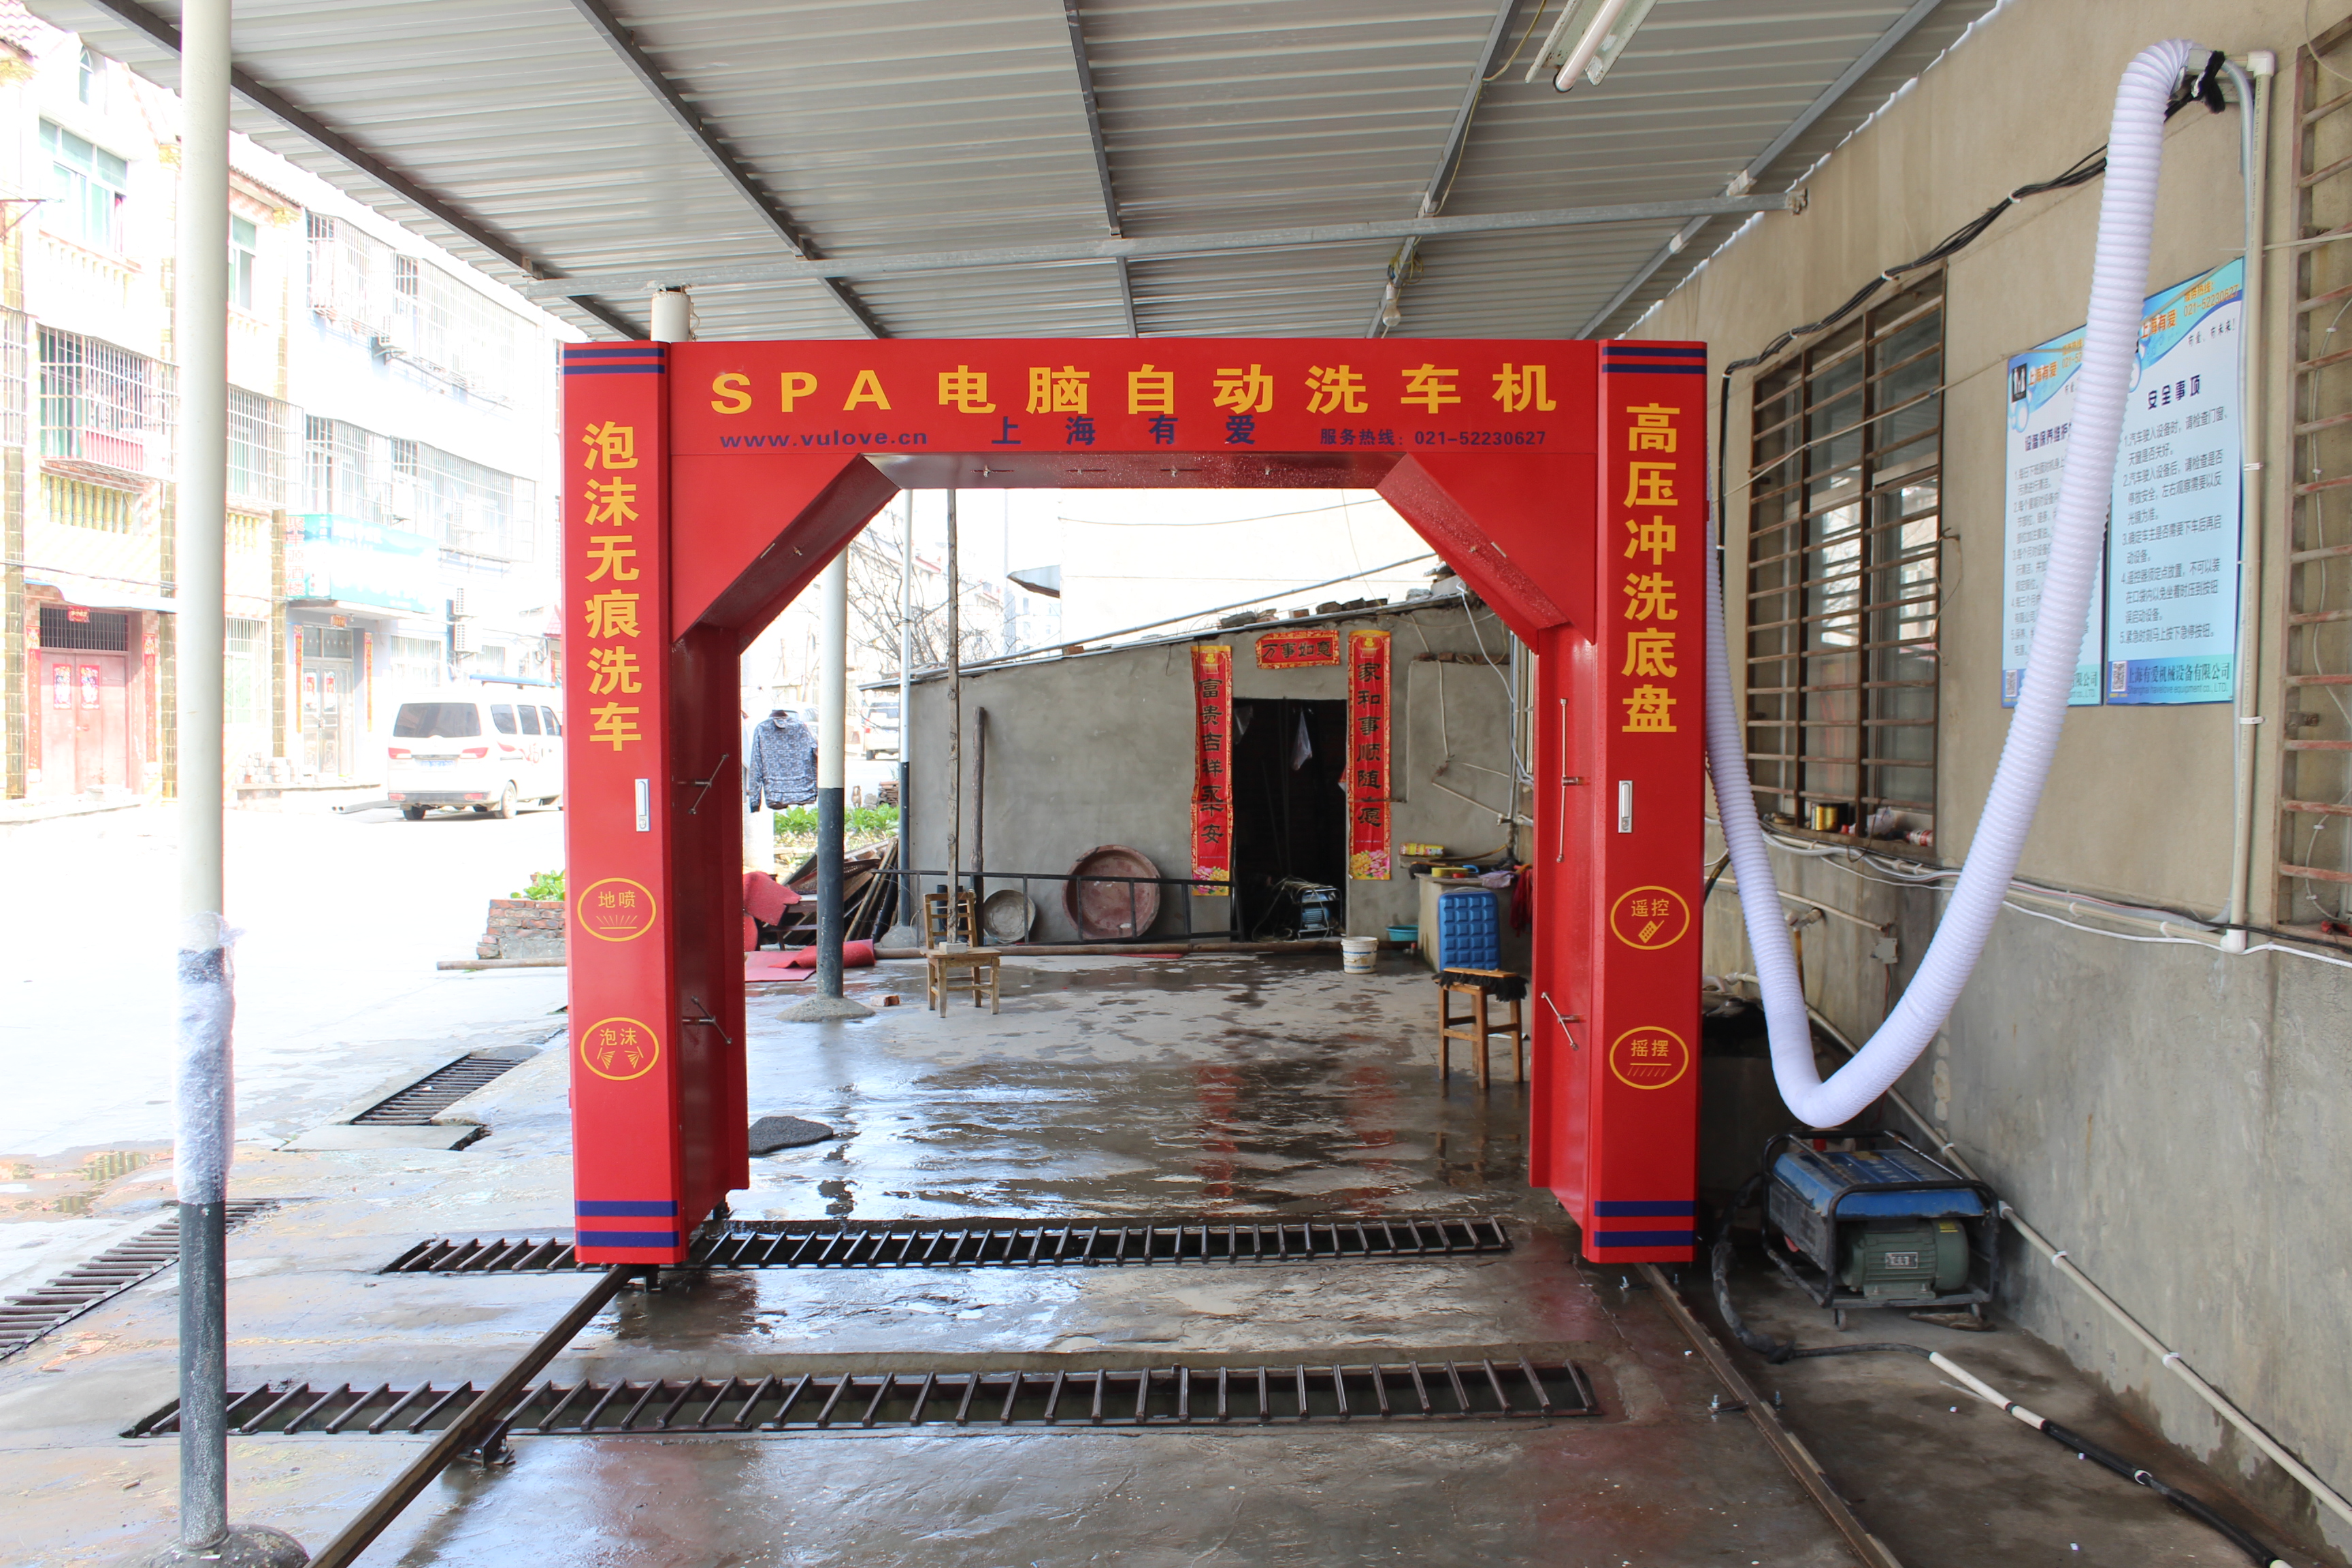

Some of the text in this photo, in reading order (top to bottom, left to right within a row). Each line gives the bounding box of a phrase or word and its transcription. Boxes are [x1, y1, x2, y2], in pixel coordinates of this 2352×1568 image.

[2183, 284, 2240, 317] 021-52230627
[2140, 309, 2177, 339] 上海有爱
[2027, 361, 2057, 386] 上海有爱
[710, 363, 1557, 415] SPA 电脑自动洗车机
[2147, 374, 2201, 411] 安全事项
[719, 429, 928, 449] www.vulove.cn
[992, 414, 1256, 446] 上海有爱
[1414, 430, 1547, 446] 021-52230627
[1621, 403, 1680, 733] 高压冲洗底盘
[582, 421, 642, 751] 泡沫无痕洗车
[1262, 640, 1332, 658] 万事如意
[2129, 662, 2230, 684] 上海有爱机械设备有限公司
[598, 890, 636, 909] 地喷
[1631, 898, 1670, 917] 遥控
[599, 1027, 638, 1047] 泡沫
[1630, 1039, 1669, 1058] 摇摆
